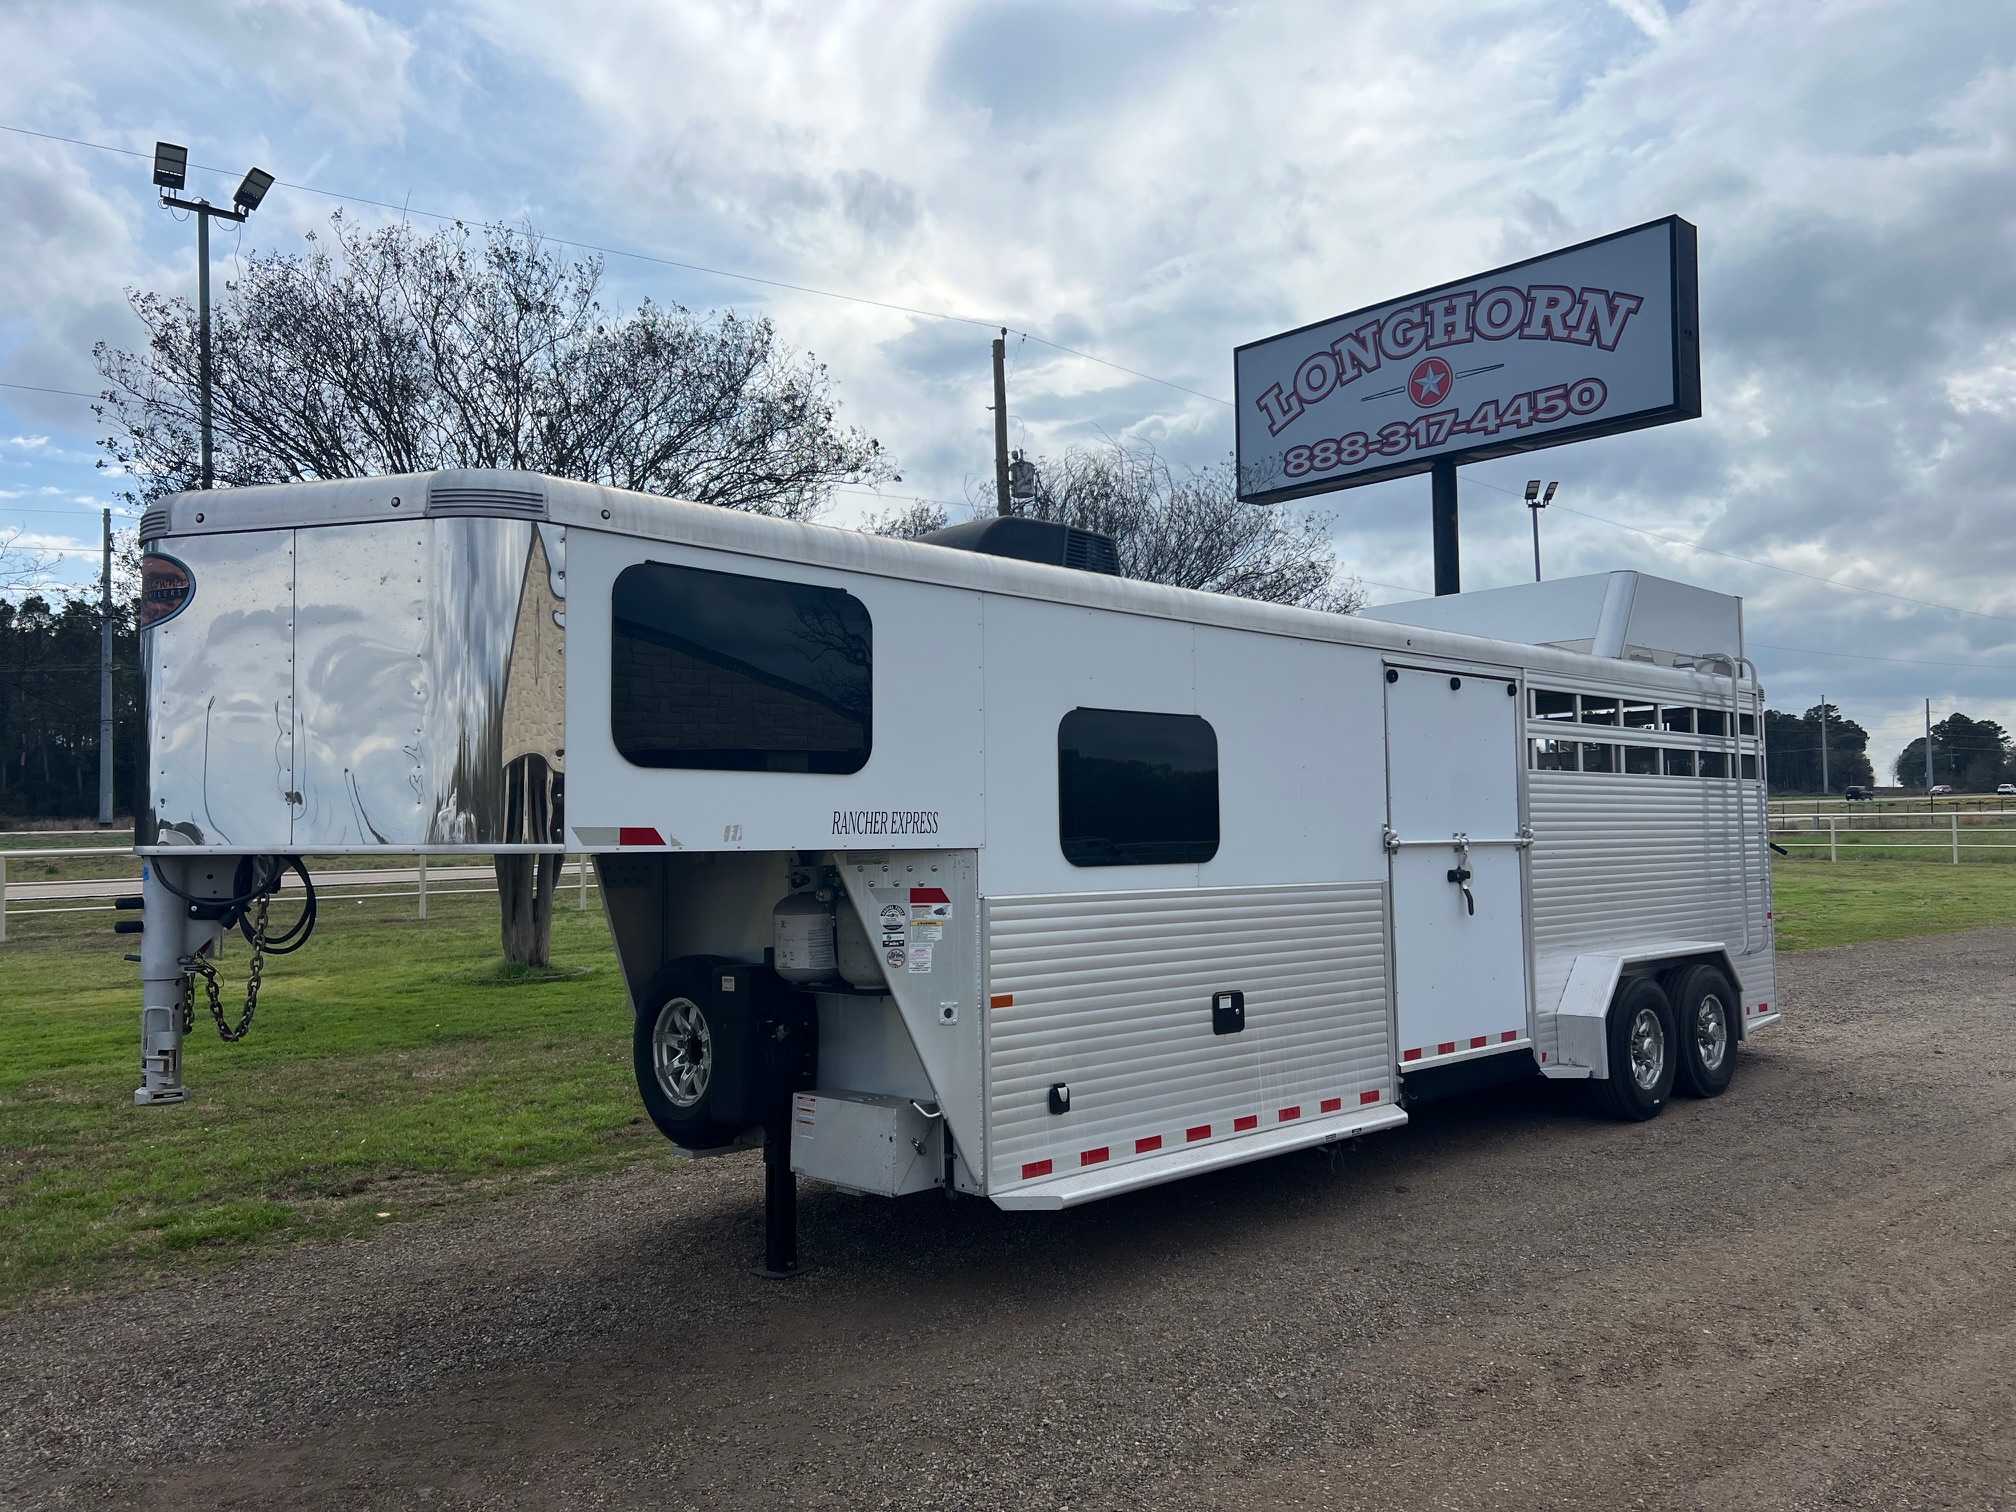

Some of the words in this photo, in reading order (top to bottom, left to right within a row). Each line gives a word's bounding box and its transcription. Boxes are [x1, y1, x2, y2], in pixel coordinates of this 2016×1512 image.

[1256, 286, 1644, 437] LONGHORN
[1283, 377, 1607, 478] 888-317-4450
[832, 811, 888, 835] RANCHER
[891, 811, 939, 834] EXPRESS
